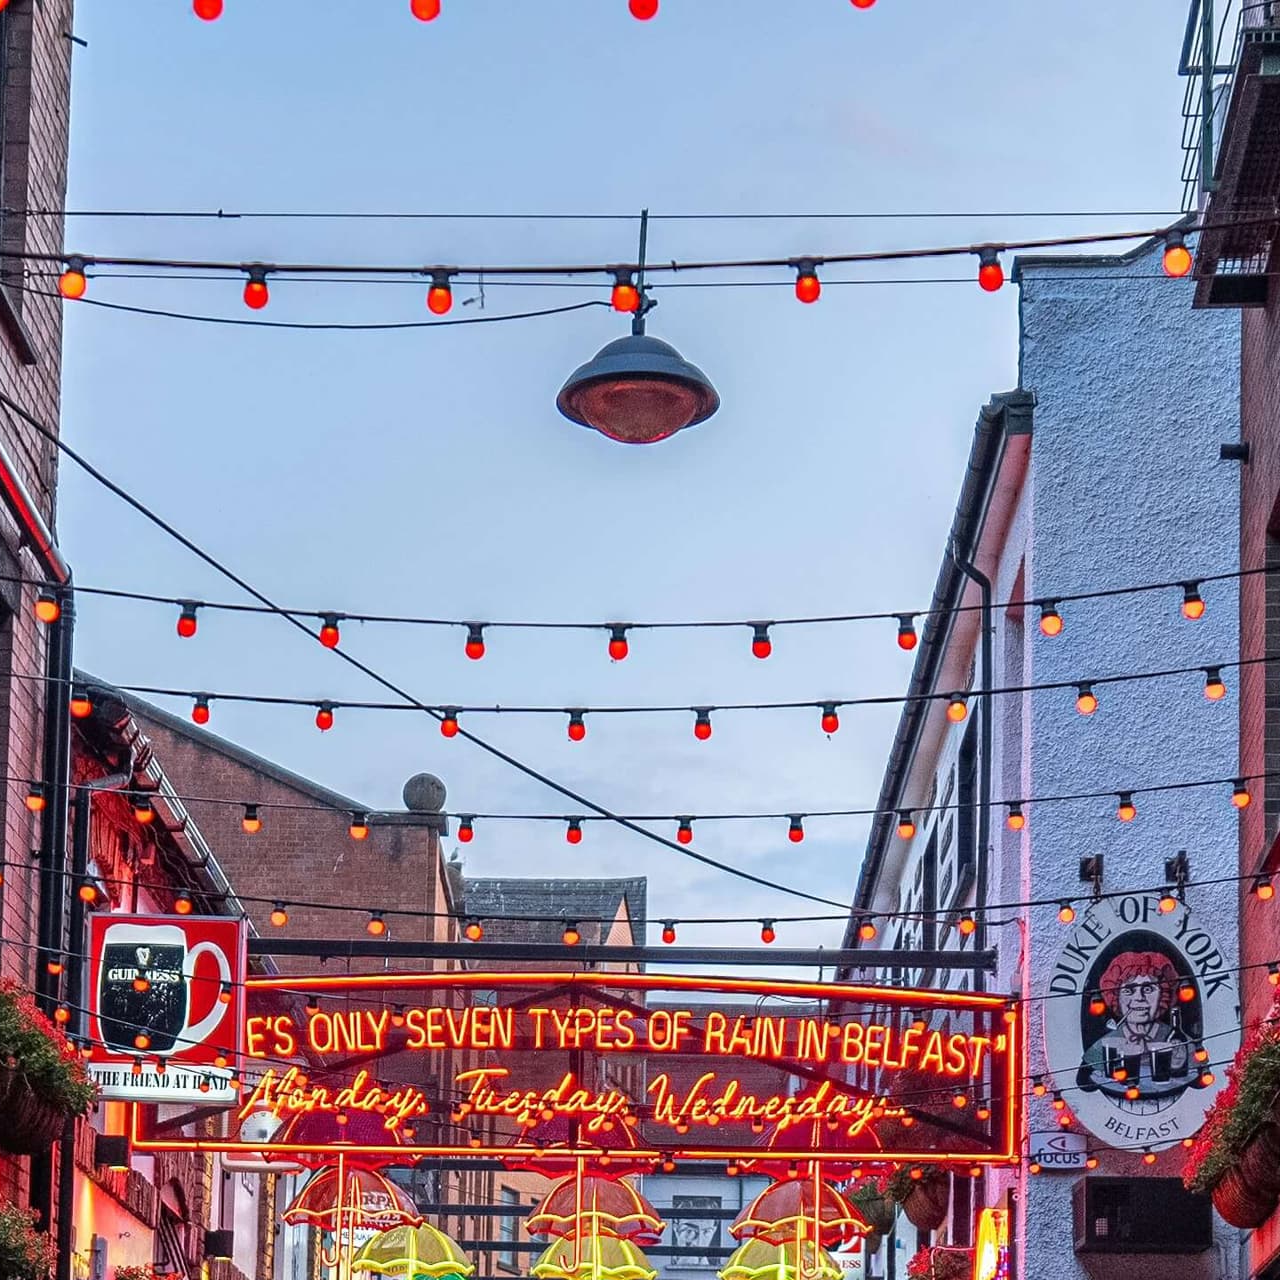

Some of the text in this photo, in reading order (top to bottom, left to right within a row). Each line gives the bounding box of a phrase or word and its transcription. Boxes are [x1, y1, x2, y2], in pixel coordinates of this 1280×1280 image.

[1049, 894, 1237, 998] DUKE OF YORK
[246, 1014, 294, 1057] E'S
[308, 1010, 390, 1053] ONLY
[405, 1006, 513, 1050] SEVEN
[528, 1007, 635, 1050] TYPES
[647, 1010, 691, 1050] OF
[705, 1011, 787, 1057] RAIN
[797, 1018, 830, 1060] IN
[94, 1071, 120, 1087] THE
[122, 1072, 169, 1089] FRIEND
[173, 1074, 189, 1089] AT
[192, 1075, 228, 1092] HND
[1104, 1115, 1180, 1141] BELFAST
[1033, 1145, 1081, 1167] focus
